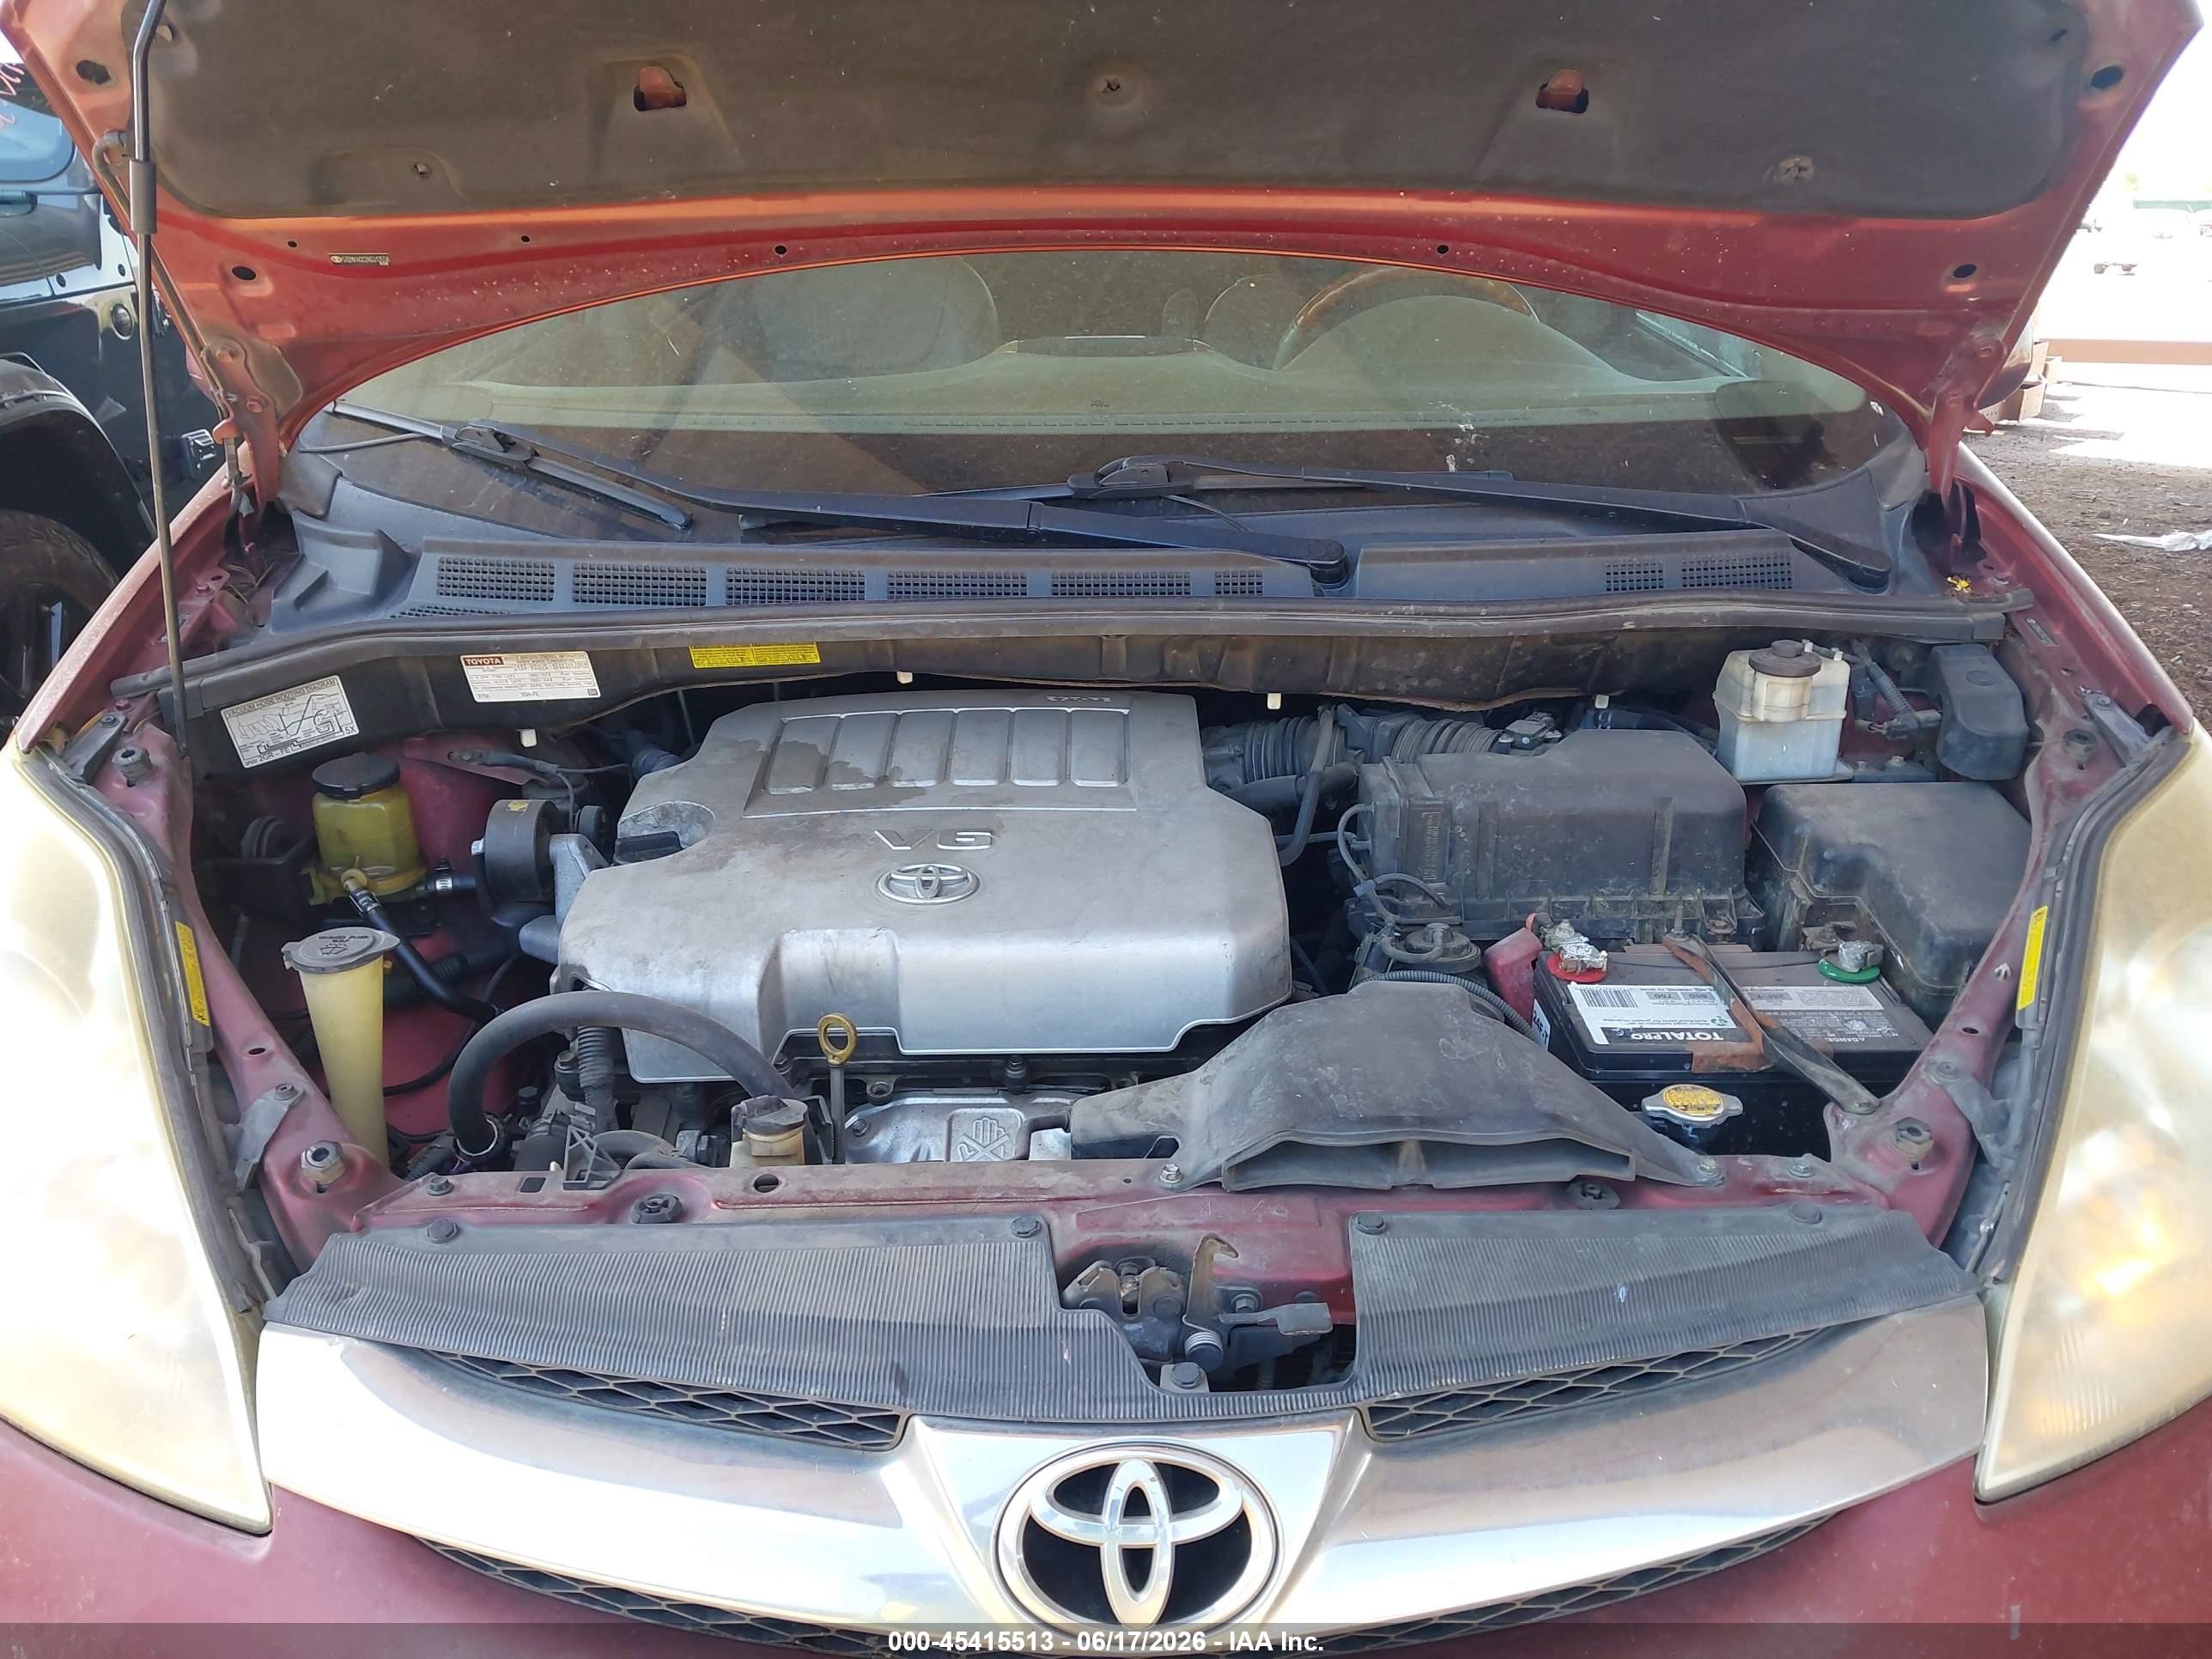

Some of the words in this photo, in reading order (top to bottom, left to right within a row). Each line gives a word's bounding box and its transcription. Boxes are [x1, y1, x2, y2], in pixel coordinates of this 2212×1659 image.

[256, 696, 275, 709] HOSE
[276, 687, 307, 702] ROUTING
[307, 678, 337, 694] DIAGRAM
[345, 726, 357, 735] 5X
[874, 830, 993, 850] V6
[1631, 1031, 1724, 1040] TOTALPRO
